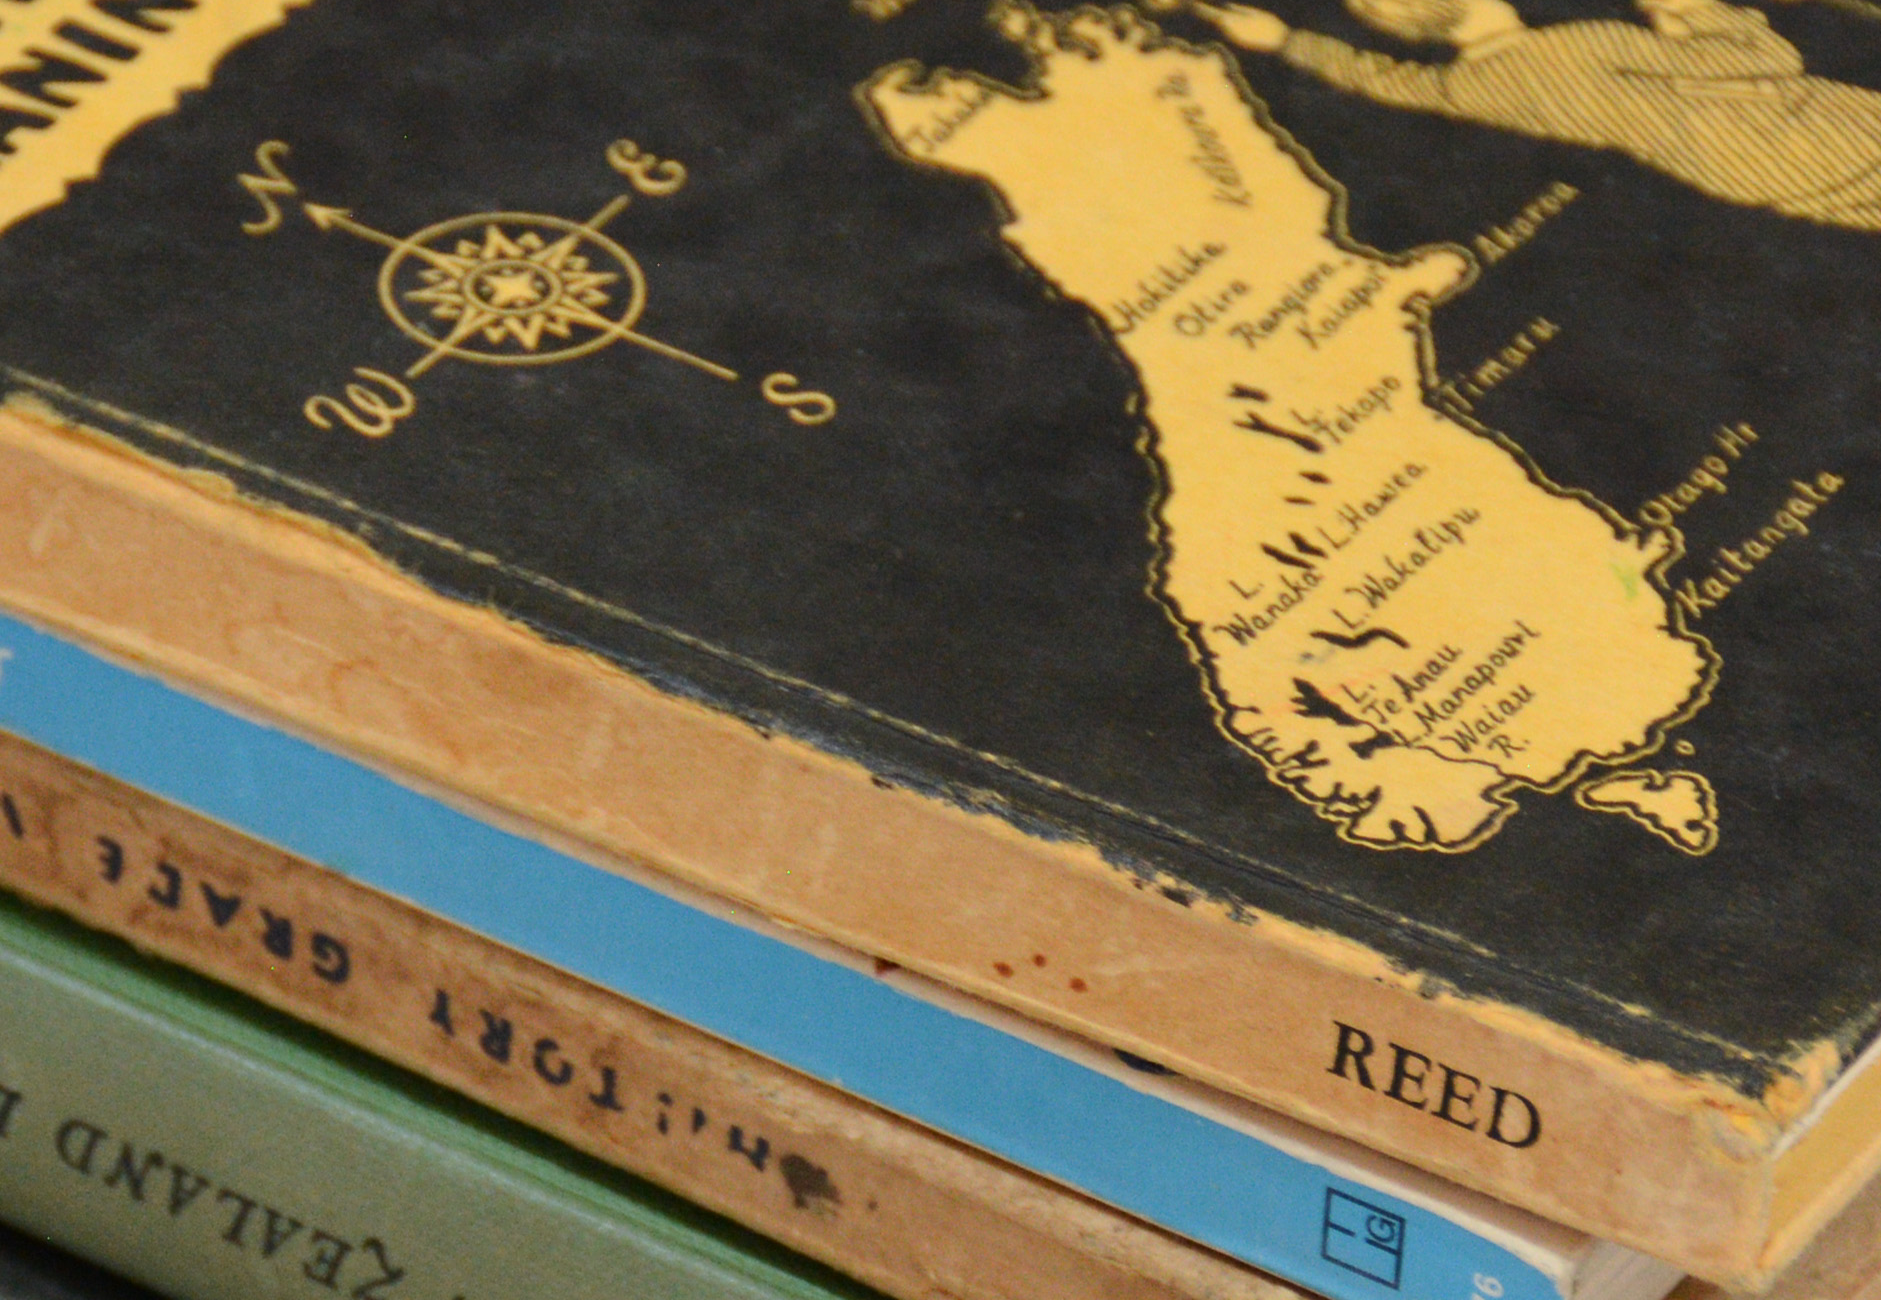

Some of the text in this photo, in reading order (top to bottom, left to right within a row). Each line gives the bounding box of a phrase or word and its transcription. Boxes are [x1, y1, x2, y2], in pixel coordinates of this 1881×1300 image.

[1472, 180, 1581, 265] Akaroa
[761, 373, 837, 425] S
[1438, 317, 1561, 412] Timaru
[1323, 374, 1402, 446] Tekapo
[1639, 450, 1727, 529] Otago
[1675, 466, 1845, 618] Kaitangata
[1214, 568, 1321, 648] Wanaka
[1441, 686, 1534, 754] Waiau
[93, 835, 351, 985] GRACE
[1326, 1020, 1542, 1150] REED
